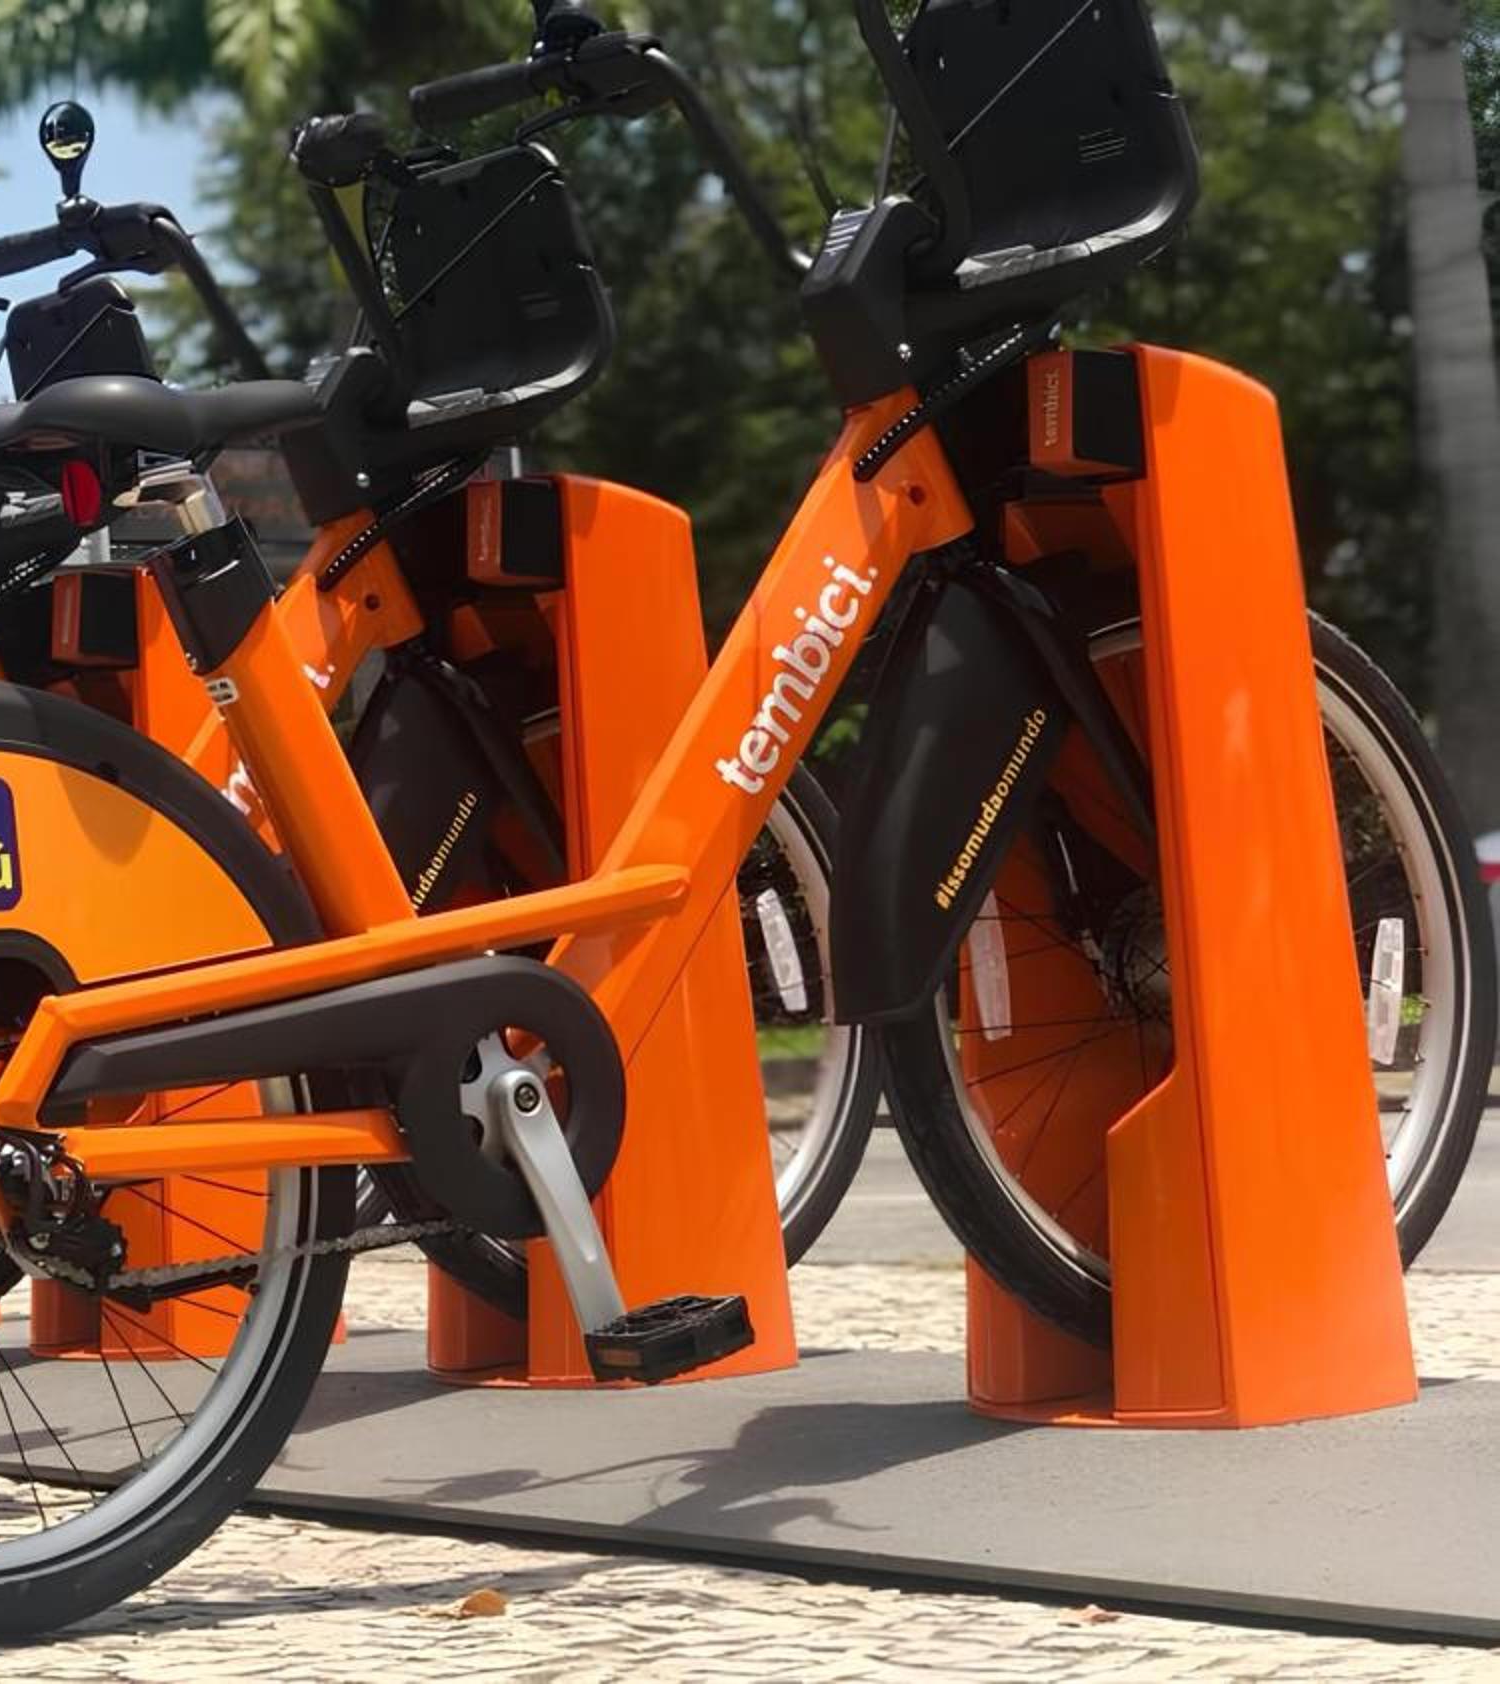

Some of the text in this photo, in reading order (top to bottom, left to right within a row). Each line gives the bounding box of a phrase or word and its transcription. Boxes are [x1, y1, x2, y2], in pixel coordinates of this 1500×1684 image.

[715, 556, 878, 794] tembici.
[411, 791, 478, 910] udaomundo
[934, 708, 1047, 911] #issomudaomundo
